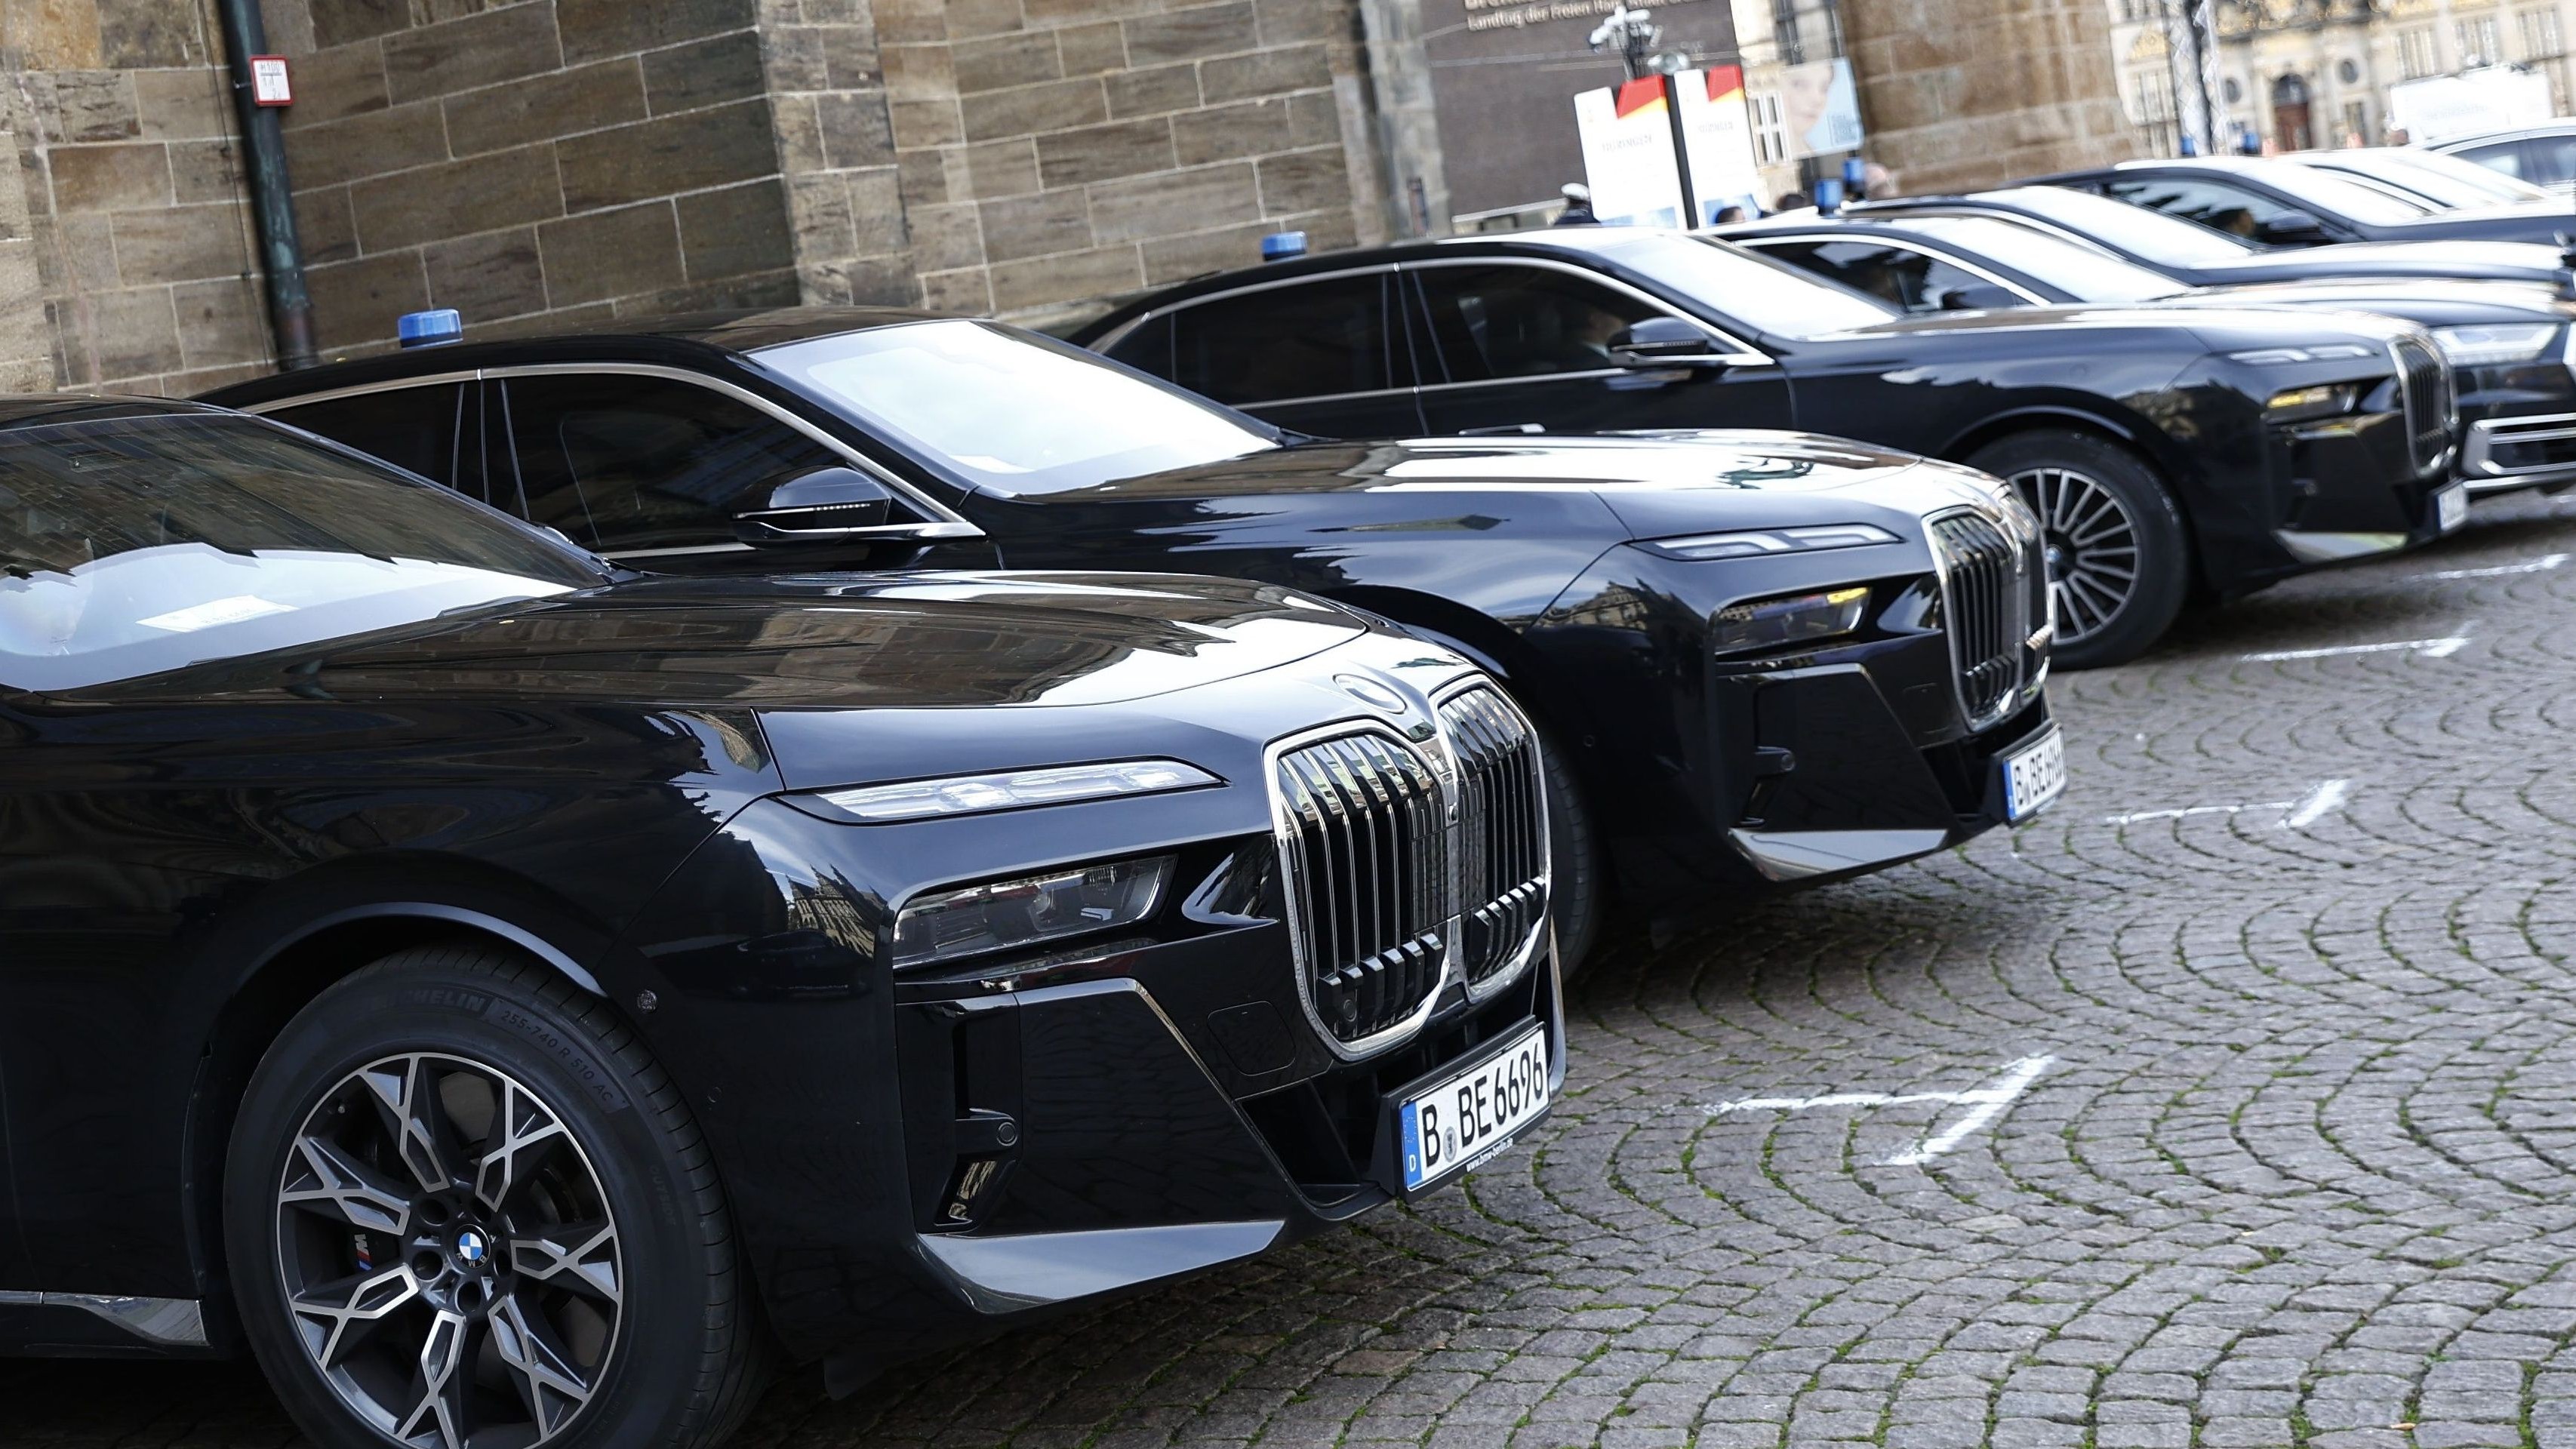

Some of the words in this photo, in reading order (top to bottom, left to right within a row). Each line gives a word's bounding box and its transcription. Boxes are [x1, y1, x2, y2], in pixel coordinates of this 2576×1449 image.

[500, 1010, 559, 1048] 255-740
[558, 1047, 571, 1060] R
[571, 1058, 595, 1081] 510
[592, 1084, 614, 1102] AC
[1408, 1154, 1417, 1172] D
[1421, 1103, 1442, 1168] B
